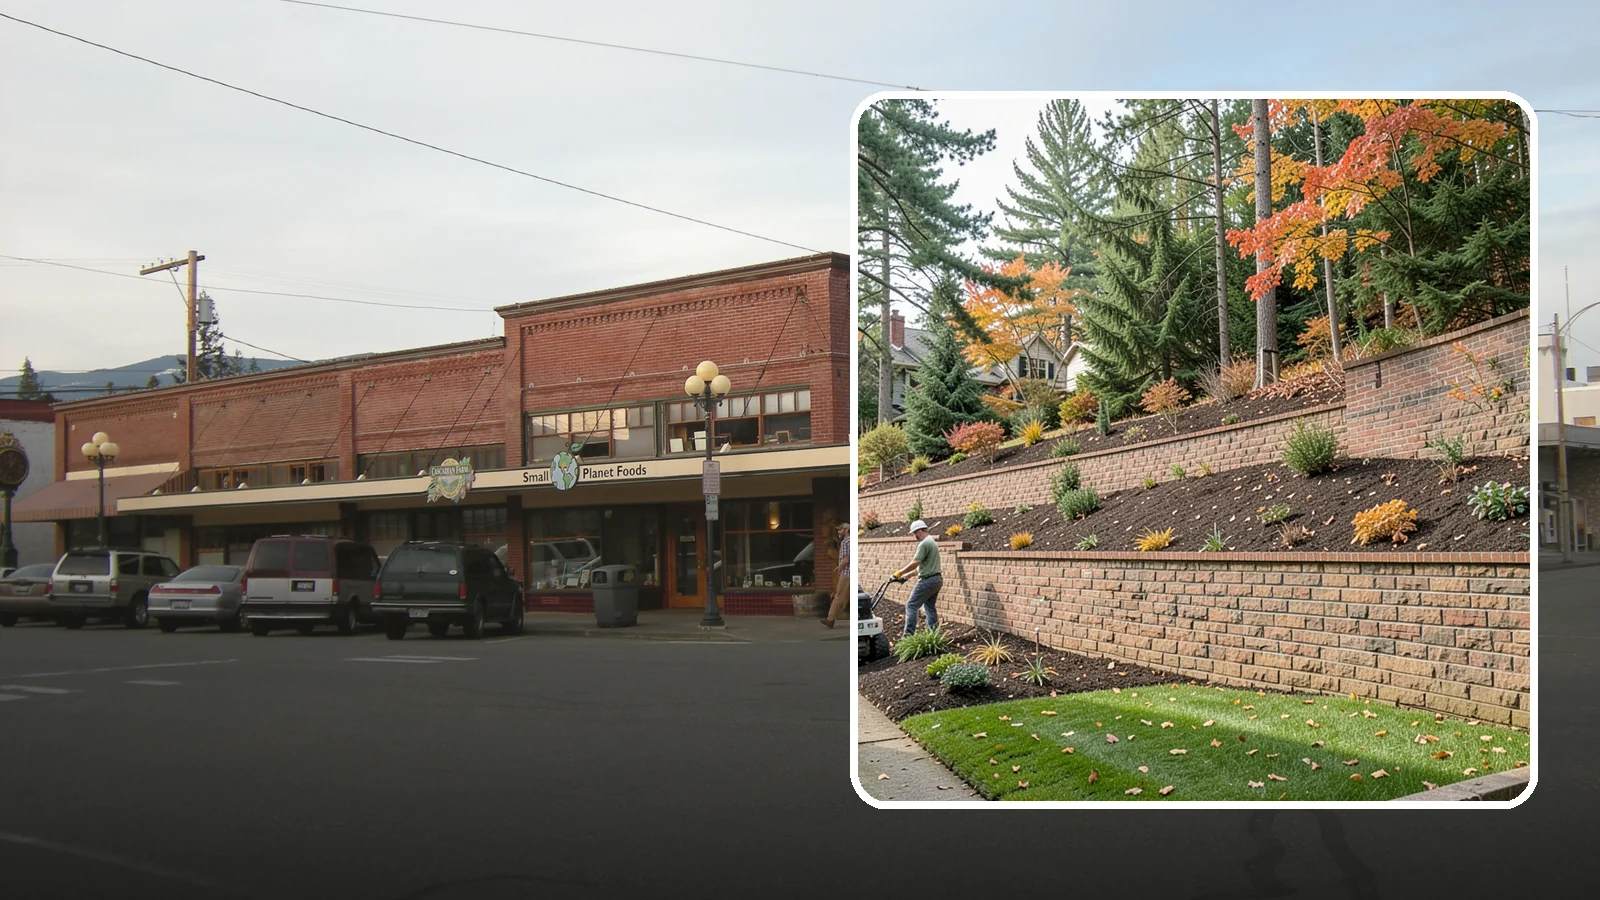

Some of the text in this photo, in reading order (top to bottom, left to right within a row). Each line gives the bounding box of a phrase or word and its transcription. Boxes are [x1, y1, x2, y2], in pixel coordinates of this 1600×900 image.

[523, 464, 646, 483] Small Planet Foods
